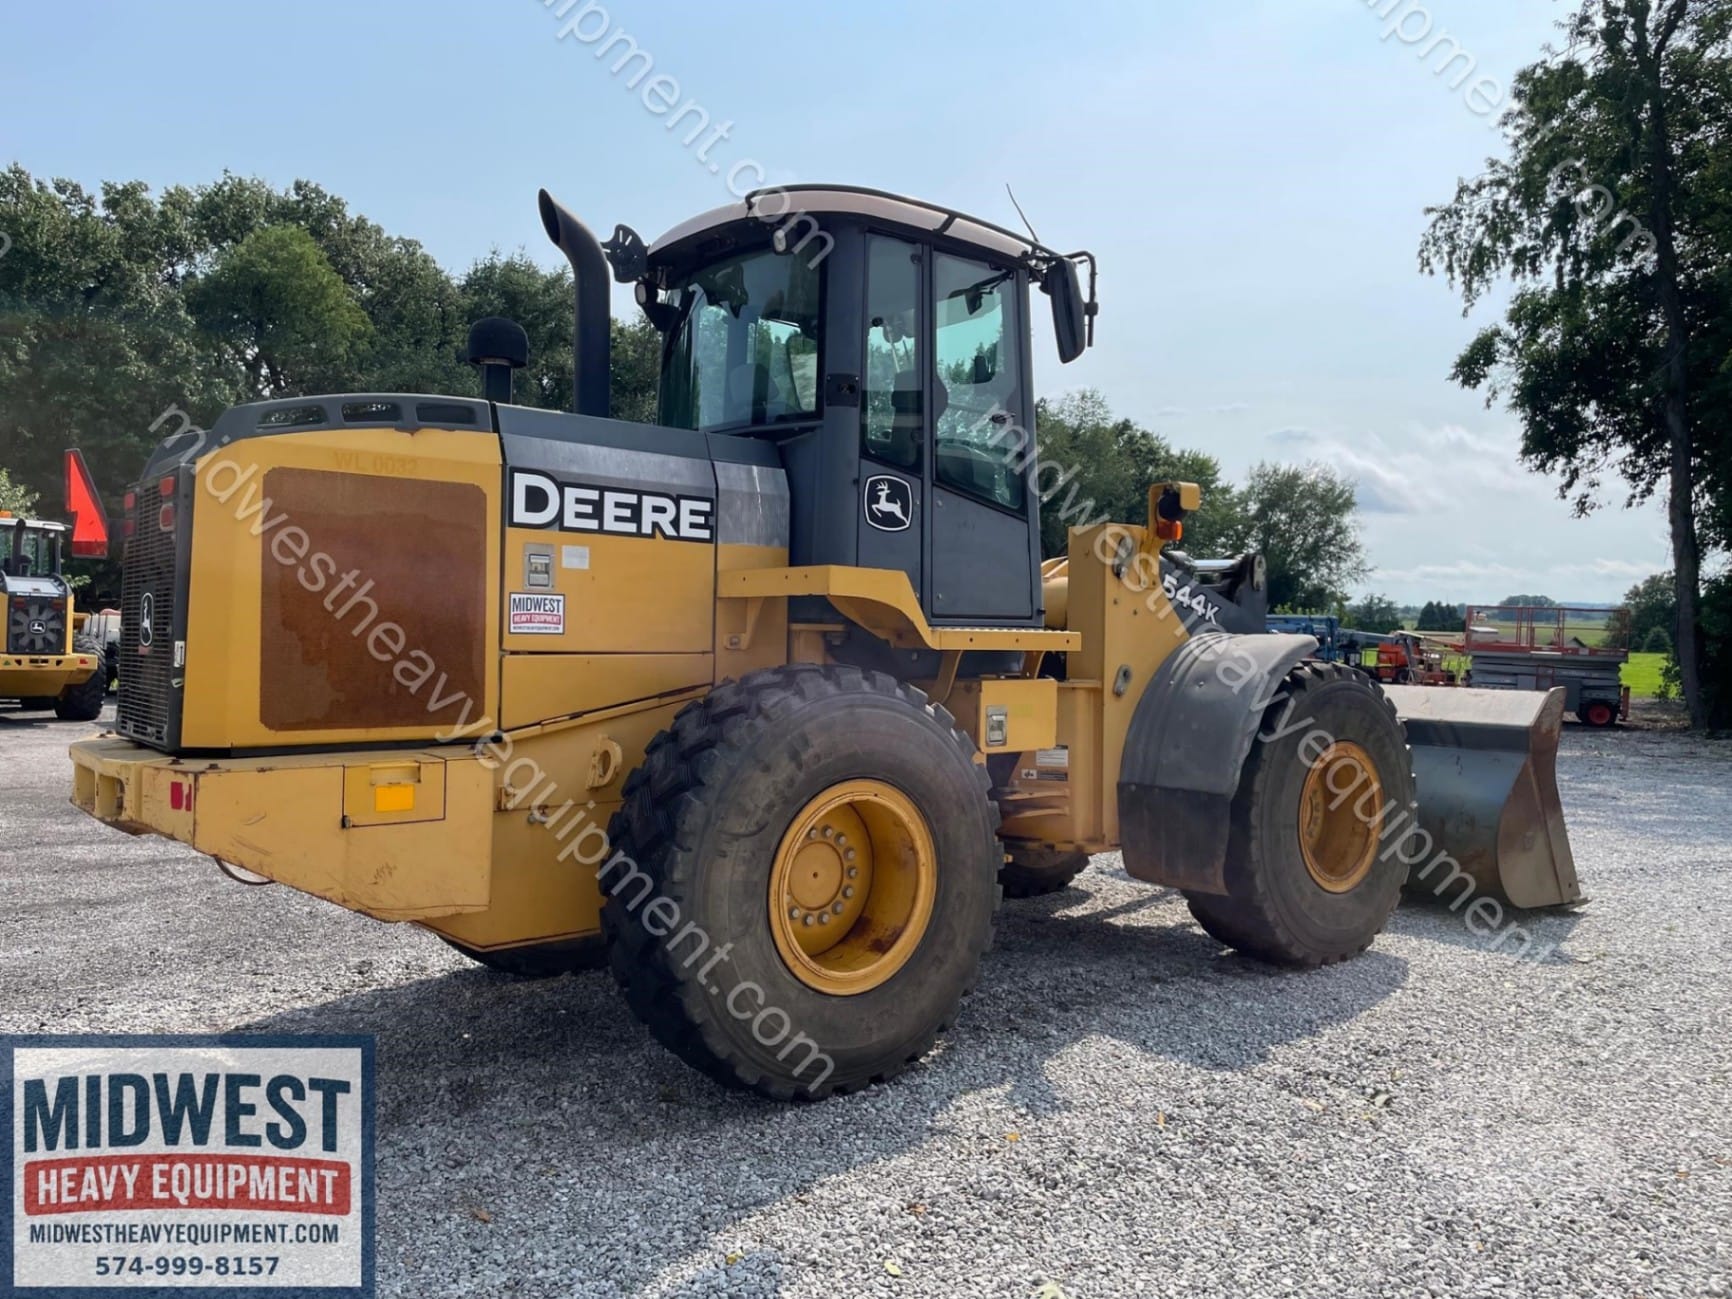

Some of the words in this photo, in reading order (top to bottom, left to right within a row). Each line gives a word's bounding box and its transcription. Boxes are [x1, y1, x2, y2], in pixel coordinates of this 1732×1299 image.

[512, 470, 713, 540] DEERE
[512, 597, 561, 613] MIDWEST
[1162, 573, 1220, 625] 544K
